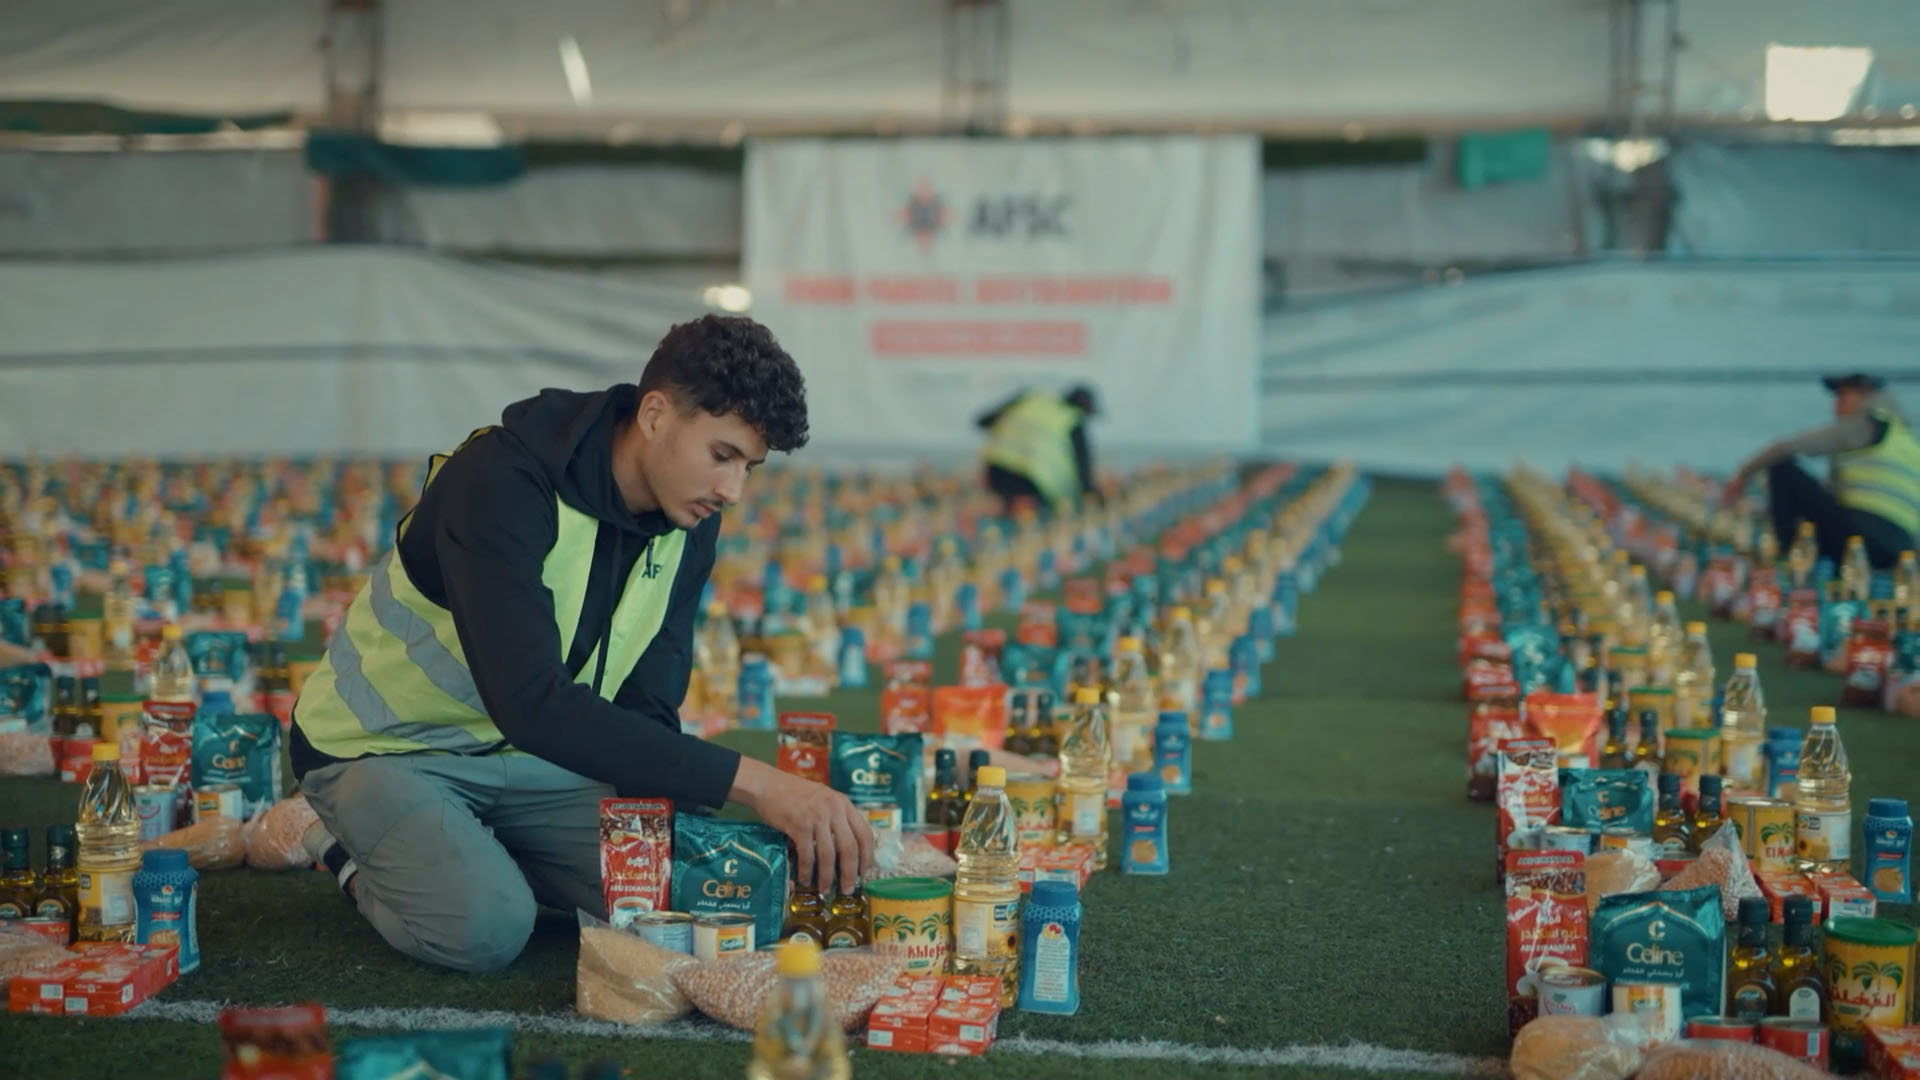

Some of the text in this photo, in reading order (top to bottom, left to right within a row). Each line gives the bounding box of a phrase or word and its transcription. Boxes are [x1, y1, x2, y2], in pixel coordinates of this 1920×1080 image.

[967, 193, 1074, 238] AFSC
[702, 879, 752, 899] Celine
[1626, 942, 1685, 966] Celine
